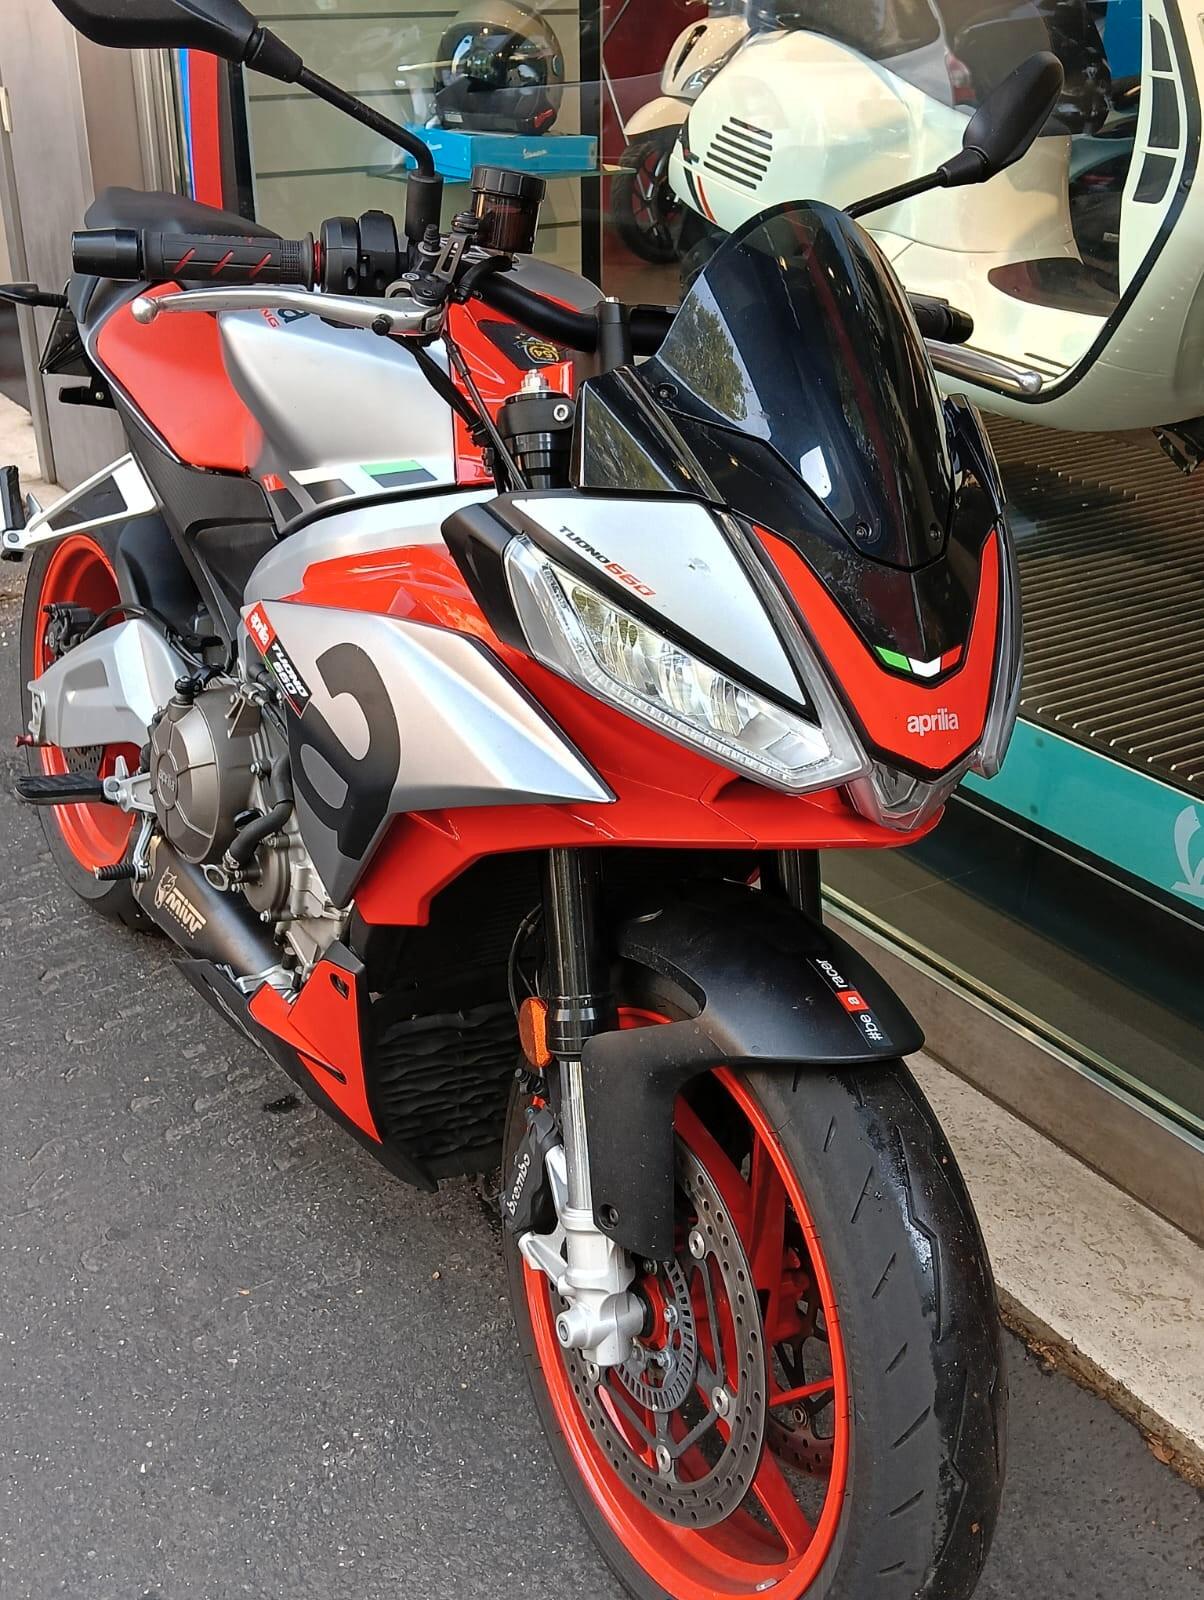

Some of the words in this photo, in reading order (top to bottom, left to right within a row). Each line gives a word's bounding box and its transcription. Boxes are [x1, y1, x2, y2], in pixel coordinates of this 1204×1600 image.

[560, 525, 610, 564] TUONO
[604, 563, 656, 596] 660
[272, 642, 309, 697] TUONO
[273, 661, 298, 695] 660
[907, 707, 960, 737] aprilia
[815, 958, 849, 989] racer
[847, 996, 860, 1006] a
[860, 1014, 884, 1041] #be
[503, 1153, 531, 1217] brembo
